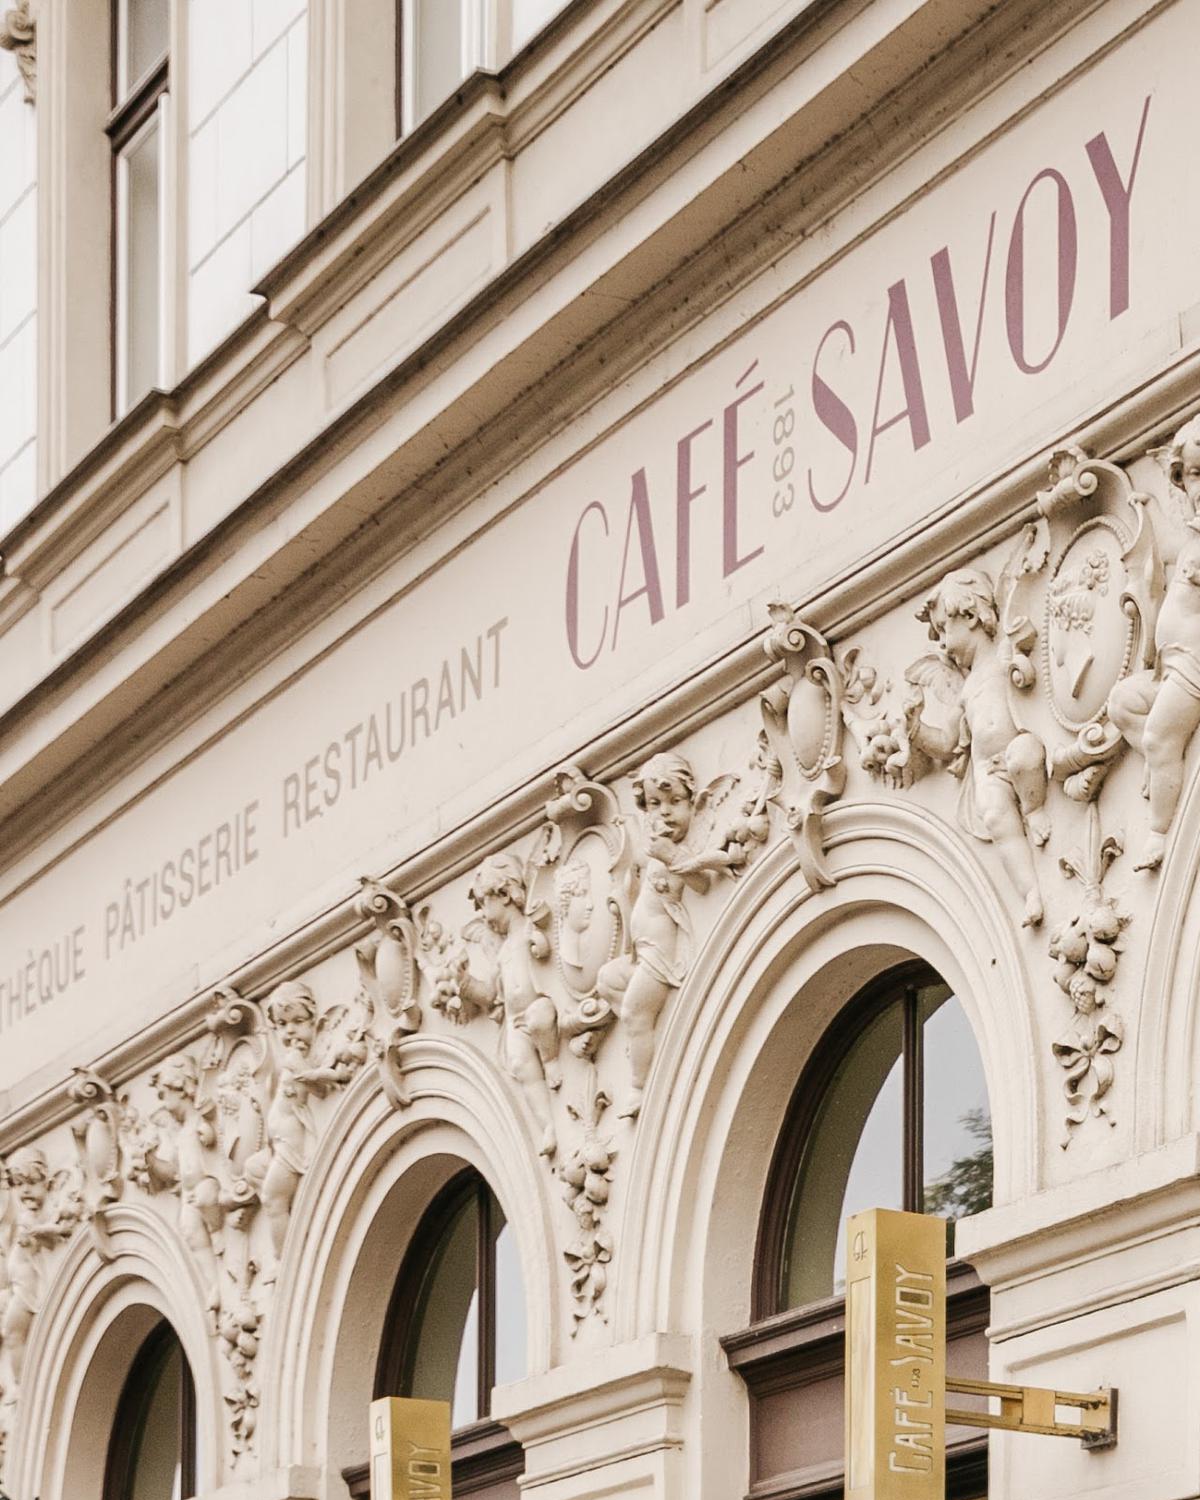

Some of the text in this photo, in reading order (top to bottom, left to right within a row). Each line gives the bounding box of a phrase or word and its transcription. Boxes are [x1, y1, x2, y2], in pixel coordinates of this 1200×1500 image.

[565, 95, 1152, 671] CAFÉ 1893 SAVOY
[104, 800, 259, 960] PÂTISSERIE
[282, 616, 509, 838] RESTAURANT
[890, 1263, 933, 1366] SAVOY
[889, 1386, 933, 1473] CAFÉ
